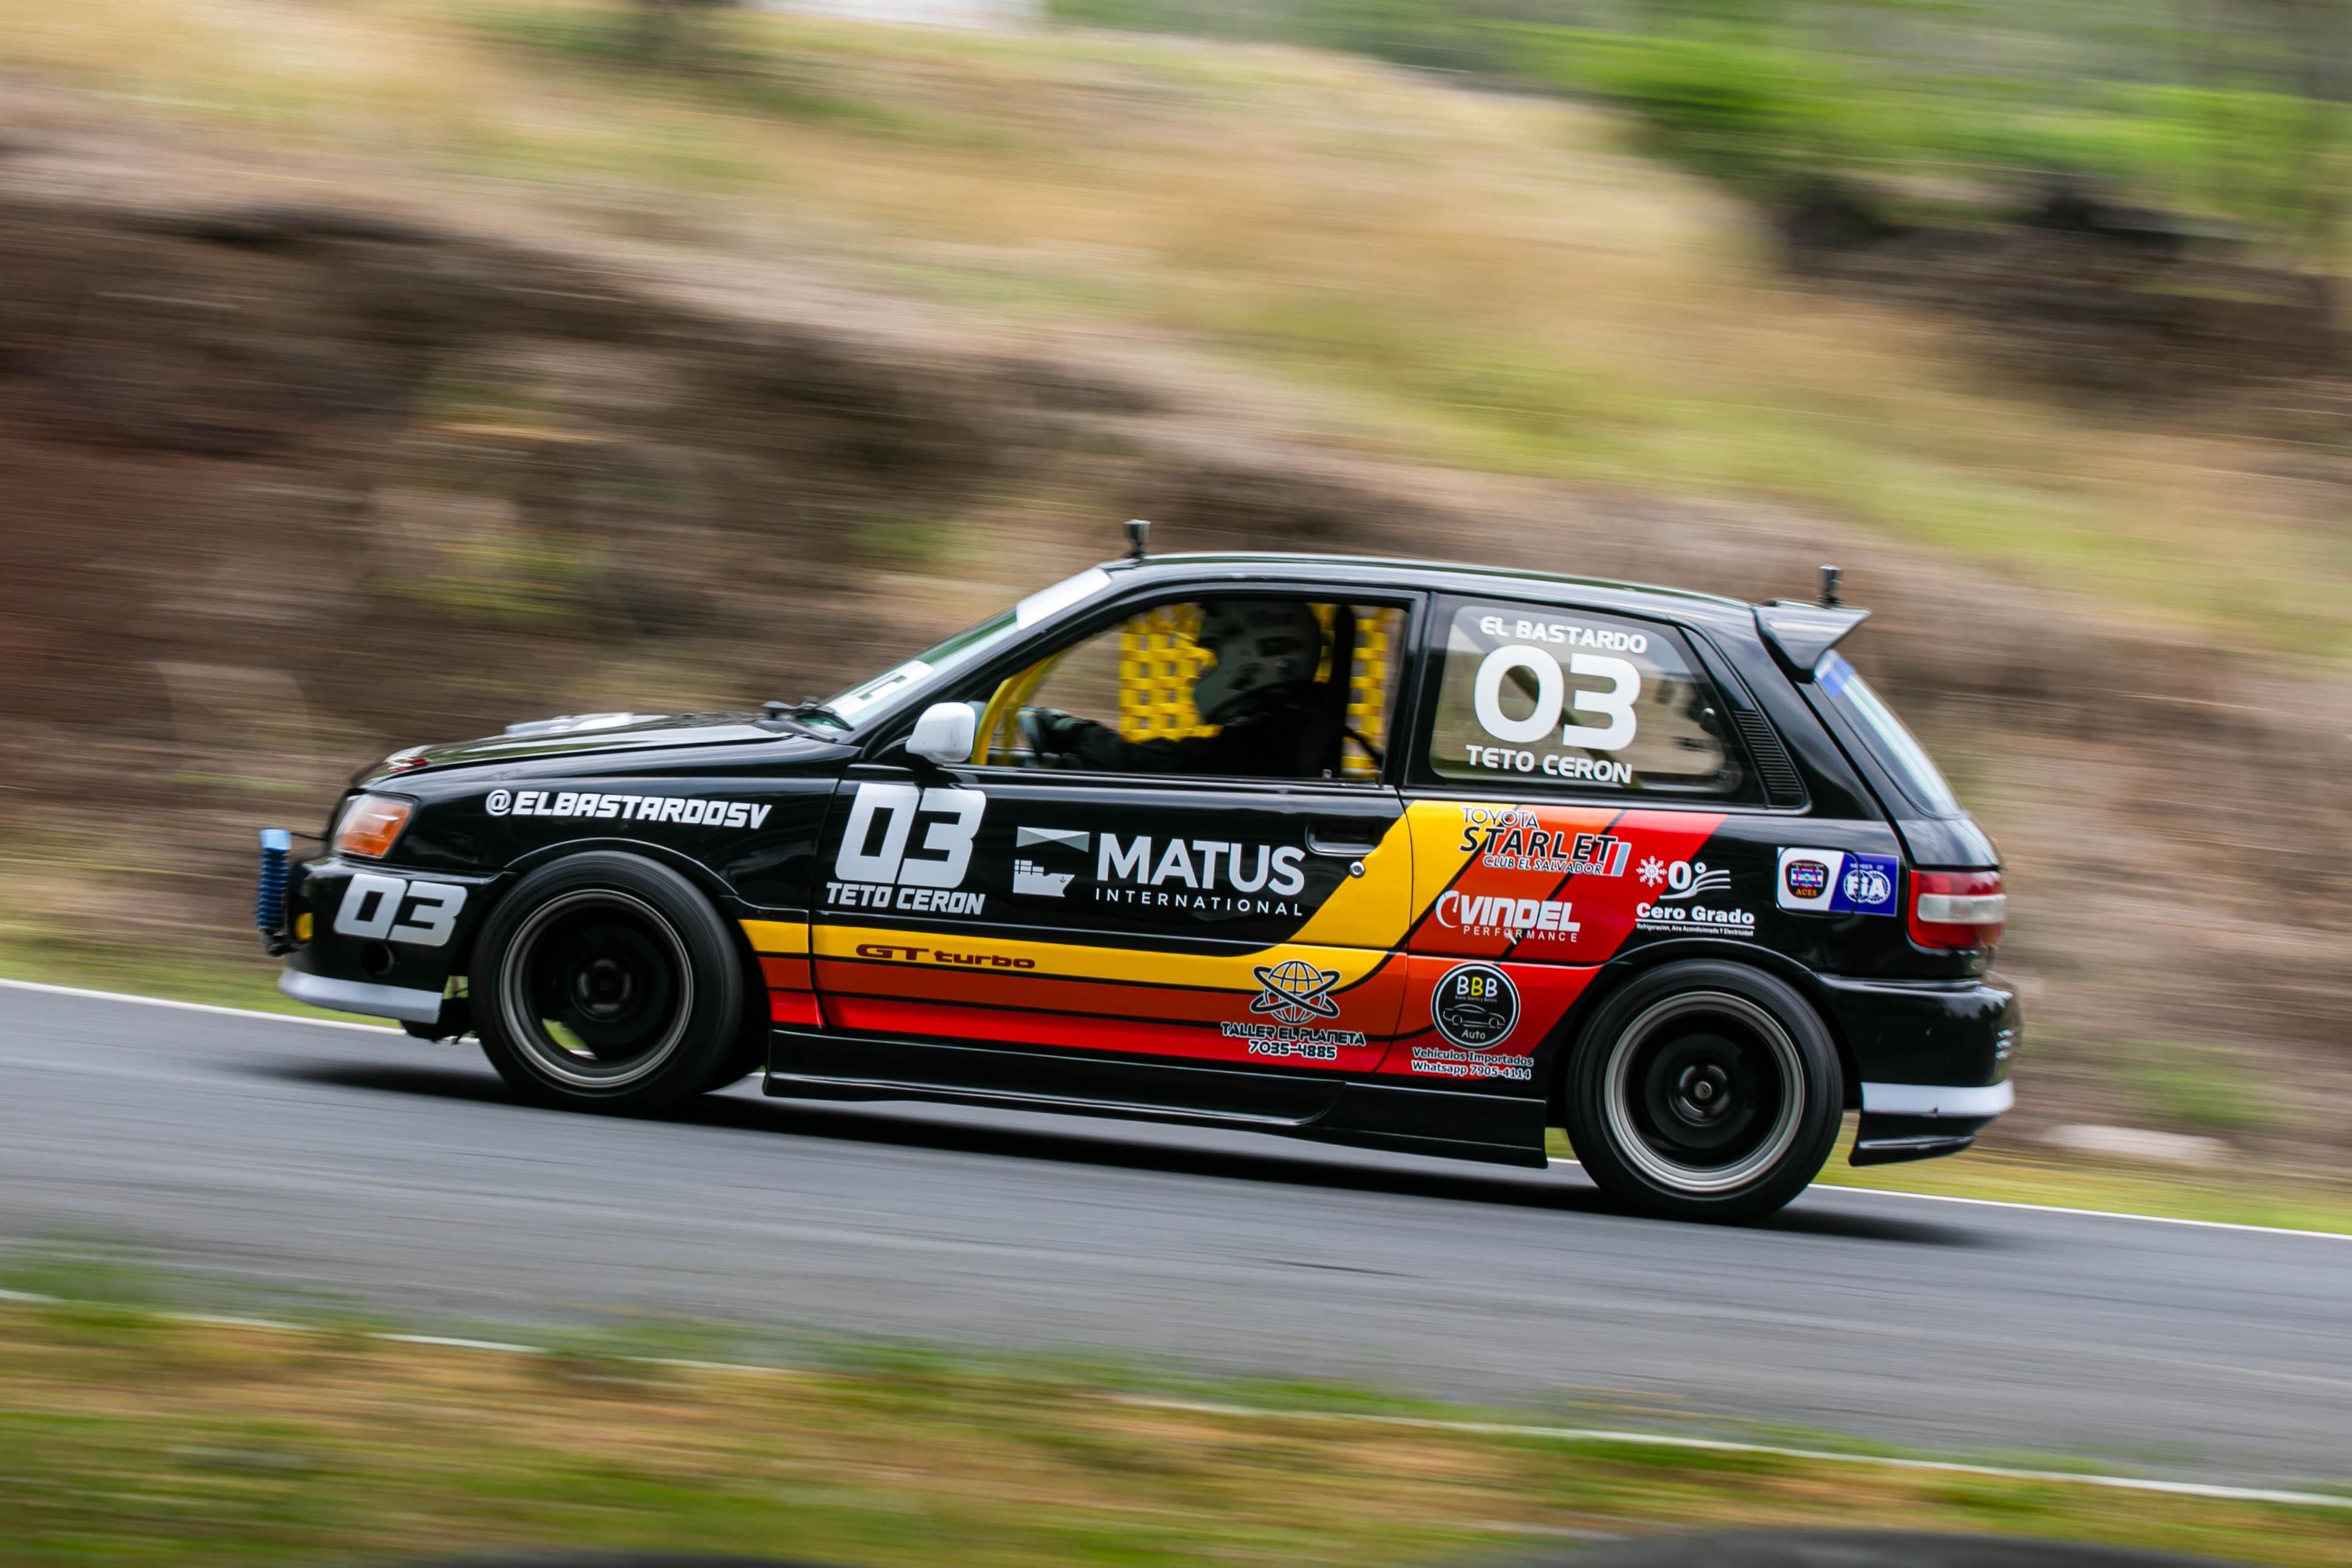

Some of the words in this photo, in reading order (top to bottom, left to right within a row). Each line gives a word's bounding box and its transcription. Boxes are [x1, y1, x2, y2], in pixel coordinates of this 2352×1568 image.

[1480, 616, 1510, 636] EL
[1516, 621, 1648, 654] BASTARDO
[1474, 645, 1641, 751] 03
[1466, 744, 1535, 772] TETO
[1543, 754, 1633, 785] CERON
[485, 789, 772, 829] @ELBASTARDOSV
[1460, 806, 1541, 830] TOYOTA
[835, 782, 987, 889] 03
[1459, 826, 1618, 863] STARLET
[1096, 832, 1306, 896] MATUS
[1483, 856, 1515, 869] CLUB
[1518, 859, 1529, 869] EL
[1532, 861, 1602, 875] SALVADOR
[334, 873, 468, 946] 03
[826, 882, 892, 908] TETO
[896, 888, 986, 915] CERON
[1096, 888, 1302, 916] INTERNATIONAL
[1461, 894, 1581, 933] VINDEL
[1636, 902, 1686, 920] Cero
[1691, 905, 1755, 924] Grado
[1463, 926, 1578, 943] PERFORMANCE
[856, 943, 930, 961] GT
[933, 950, 1036, 970] turbo
[1221, 1022, 1276, 1040] TALLER
[1278, 1027, 1297, 1041] EL
[1298, 1028, 1366, 1047] PLANETA
[1461, 1029, 1486, 1040] Auto
[1248, 1039, 1337, 1060] 7035-4885
[1468, 1051, 1534, 1066] Importados
[1411, 1060, 1468, 1077] Whatsapp
[1470, 1065, 1532, 1080] 7905-4114
